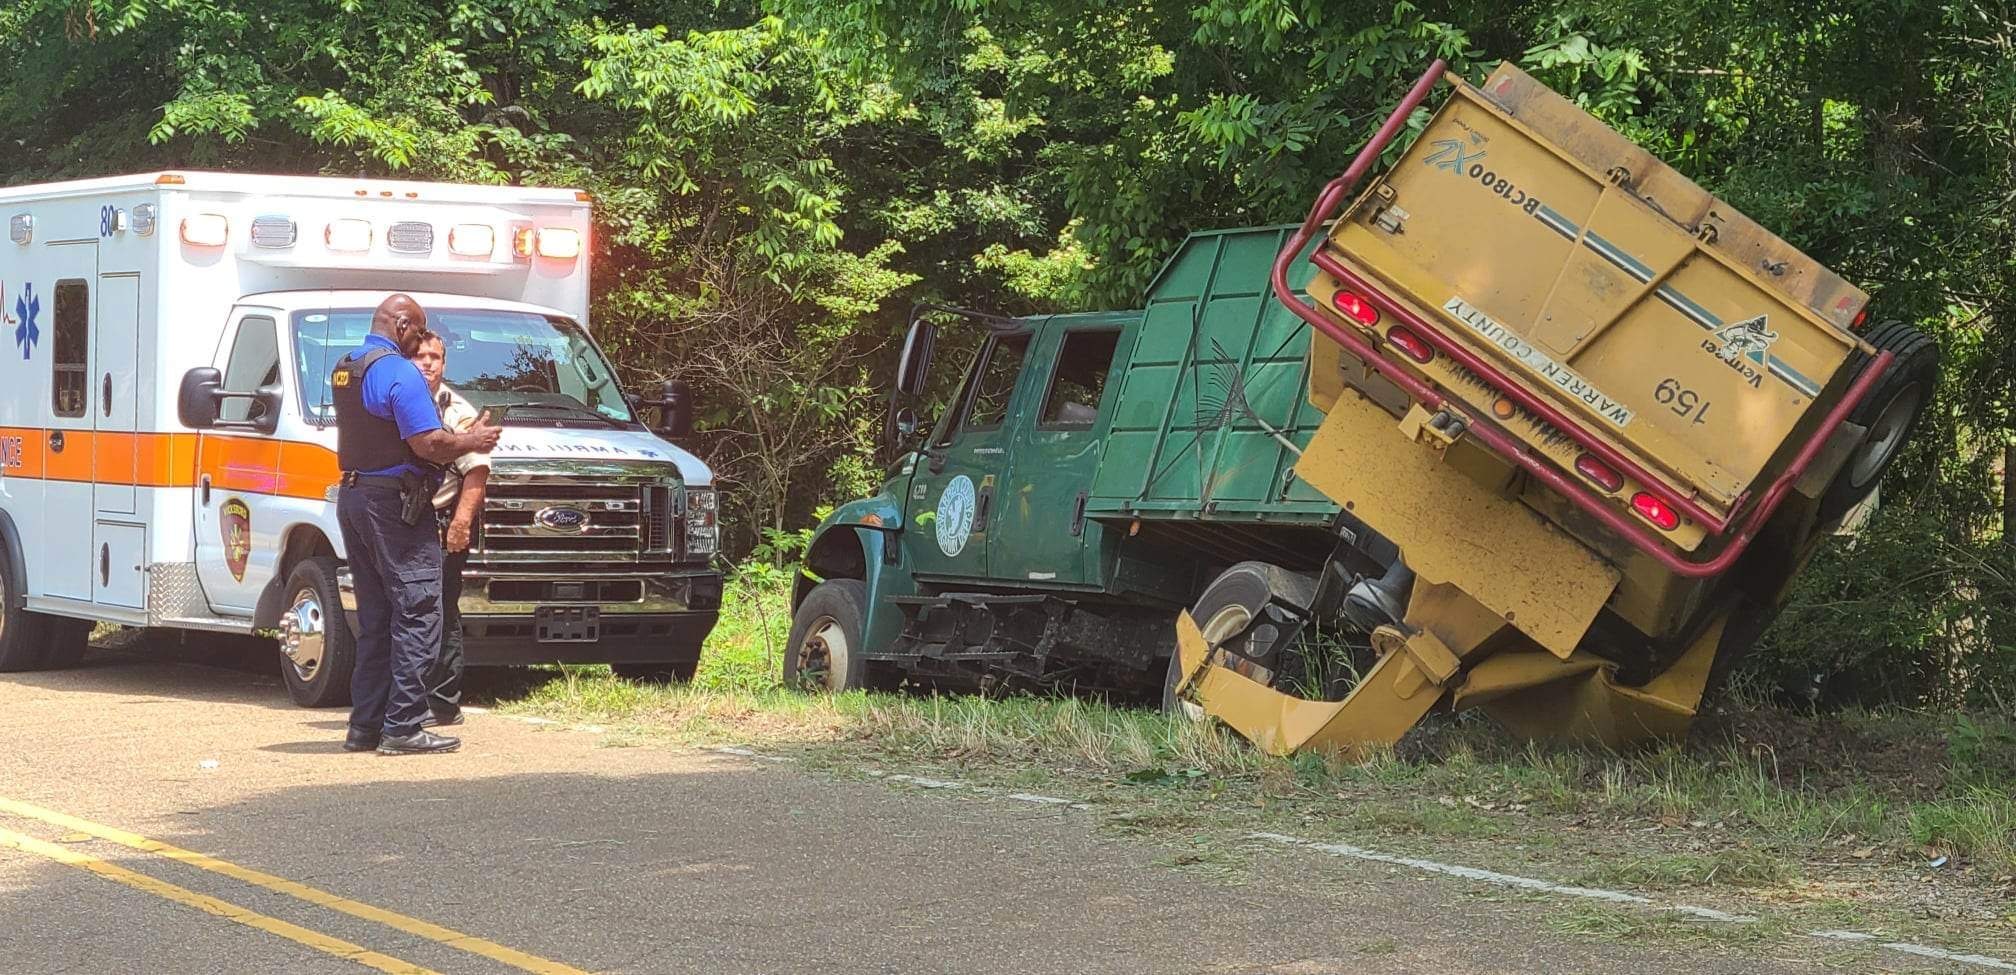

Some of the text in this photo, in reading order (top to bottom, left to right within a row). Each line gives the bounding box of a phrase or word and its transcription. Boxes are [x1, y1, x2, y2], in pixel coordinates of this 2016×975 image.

[1423, 140, 1540, 215] BC1800 XL
[1449, 301, 1629, 424] WARREN COUNTY
[1700, 339, 1763, 388] Vermeer
[1654, 378, 1710, 424] 159
[553, 511, 577, 523] Ford
